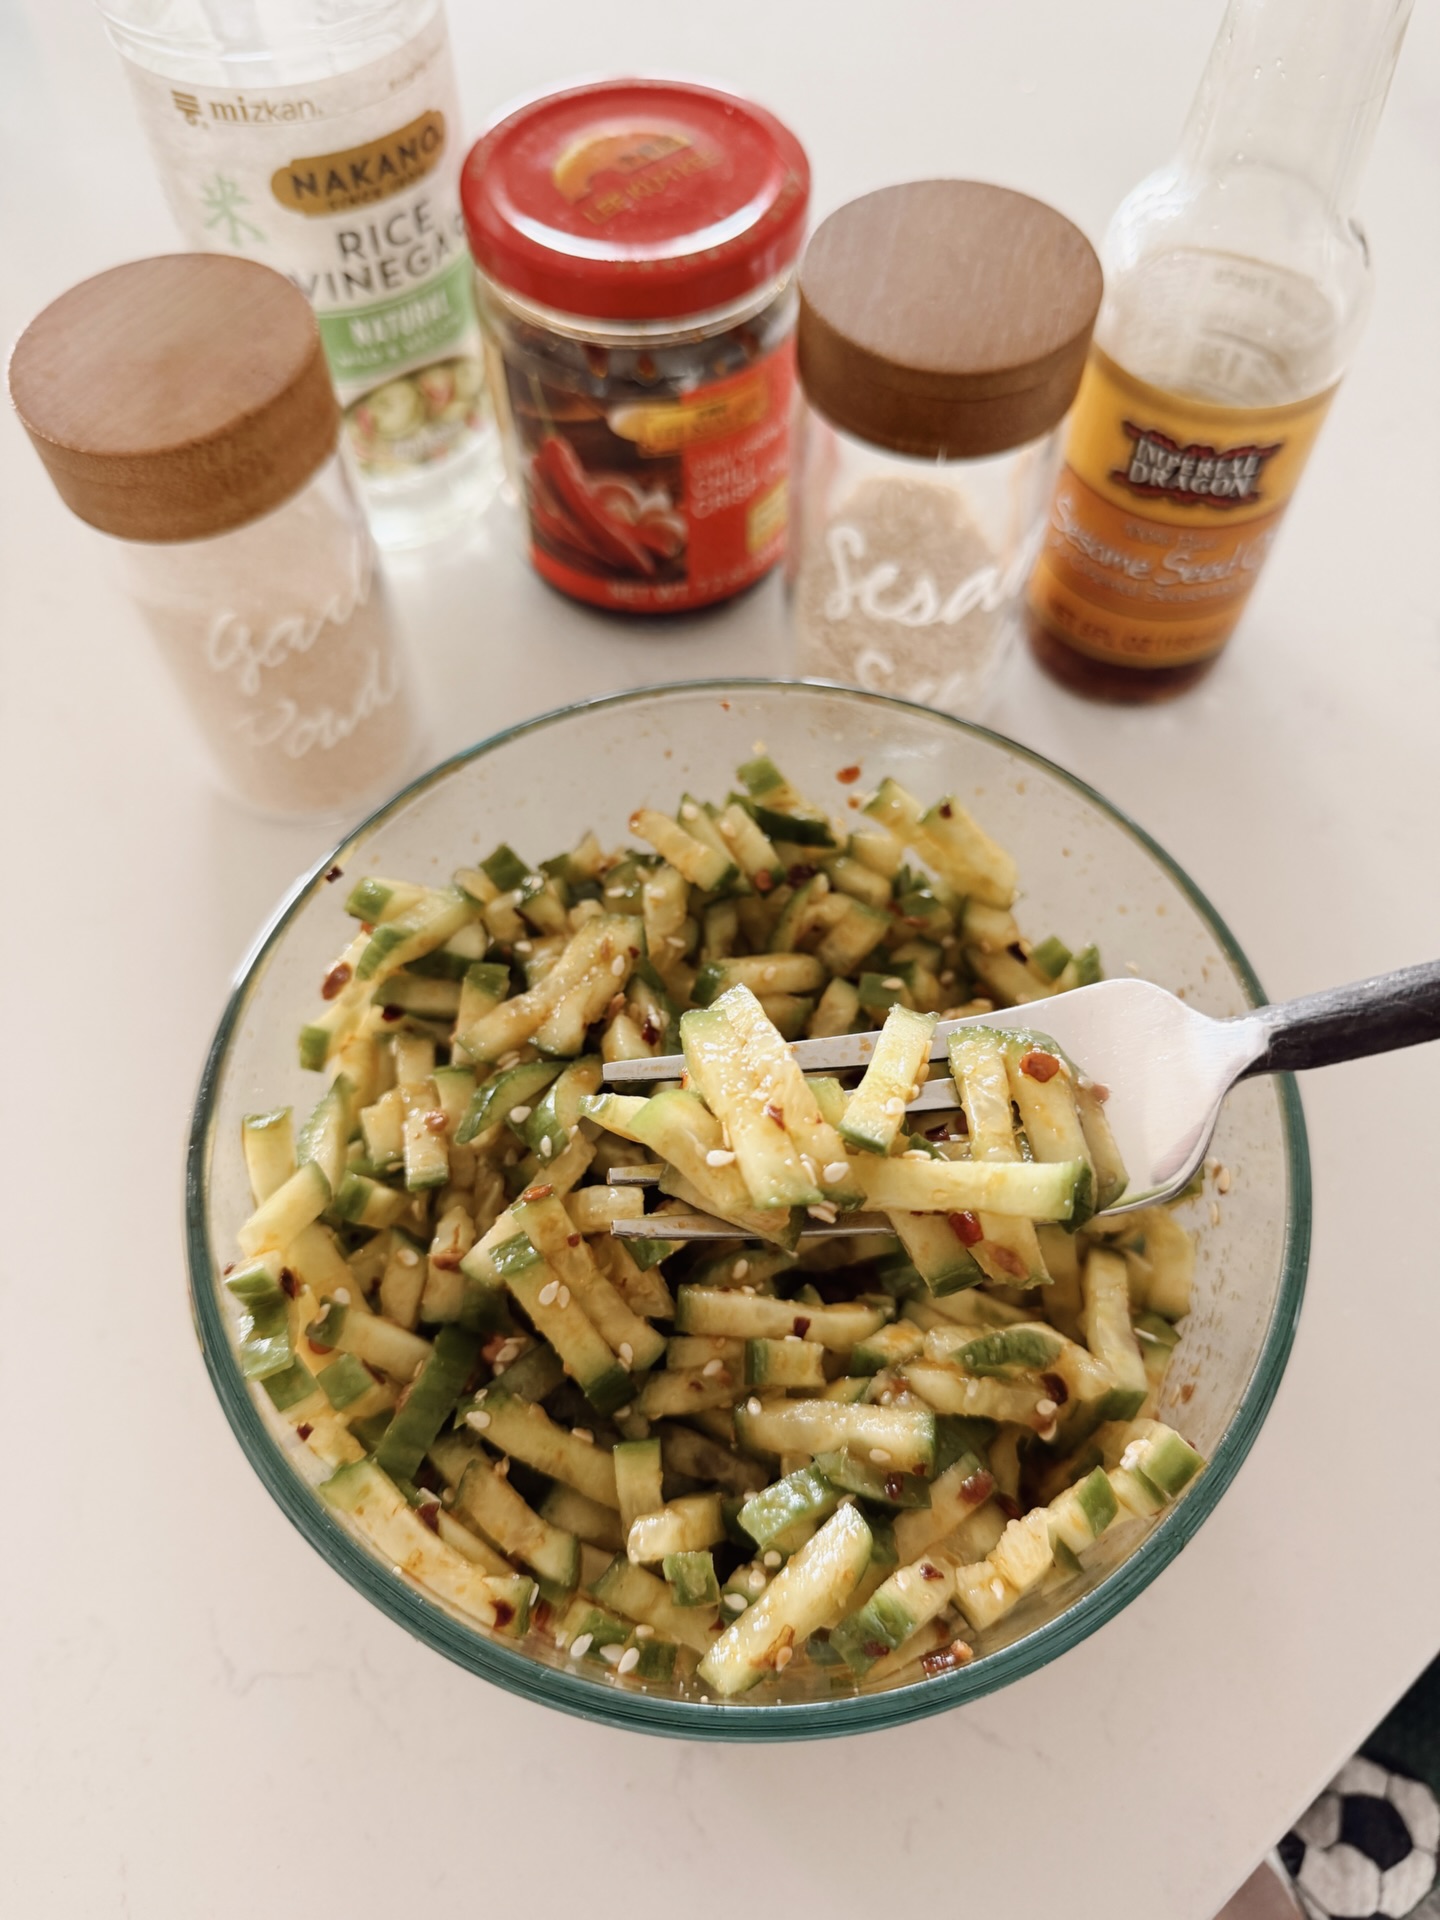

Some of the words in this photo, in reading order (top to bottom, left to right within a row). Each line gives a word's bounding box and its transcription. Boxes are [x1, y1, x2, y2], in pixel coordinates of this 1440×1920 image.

[291, 124, 440, 200] NAKANO
[337, 198, 434, 263] RICE
[1129, 459, 1253, 499] DRAGON
[1051, 494, 1151, 580] Sesame
[1152, 542, 1243, 586] Seed
